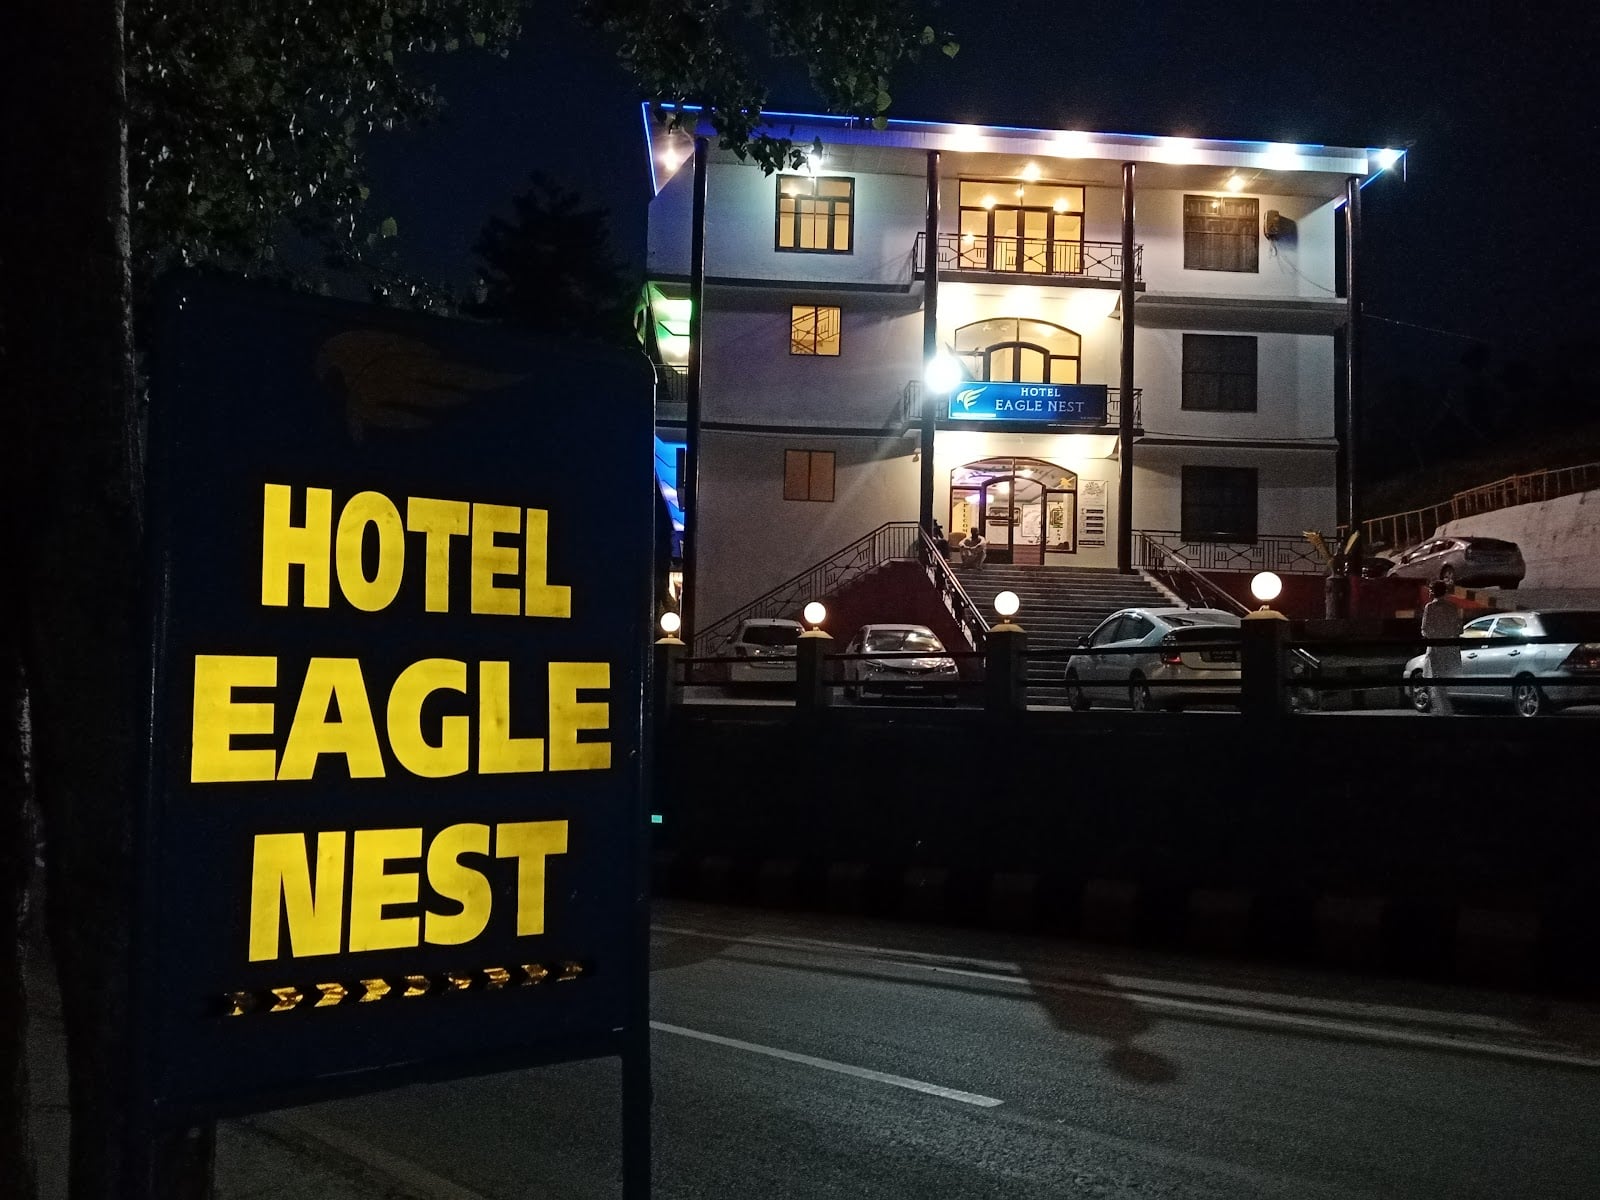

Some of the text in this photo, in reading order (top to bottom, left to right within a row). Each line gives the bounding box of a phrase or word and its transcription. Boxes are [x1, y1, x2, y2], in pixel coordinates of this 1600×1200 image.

[995, 399, 1085, 413] EAGLE NEST
[1020, 387, 1061, 397] HOTEL
[261, 483, 572, 619] HOTEL
[190, 654, 612, 784] EAGLE
[248, 819, 569, 962] NEST
